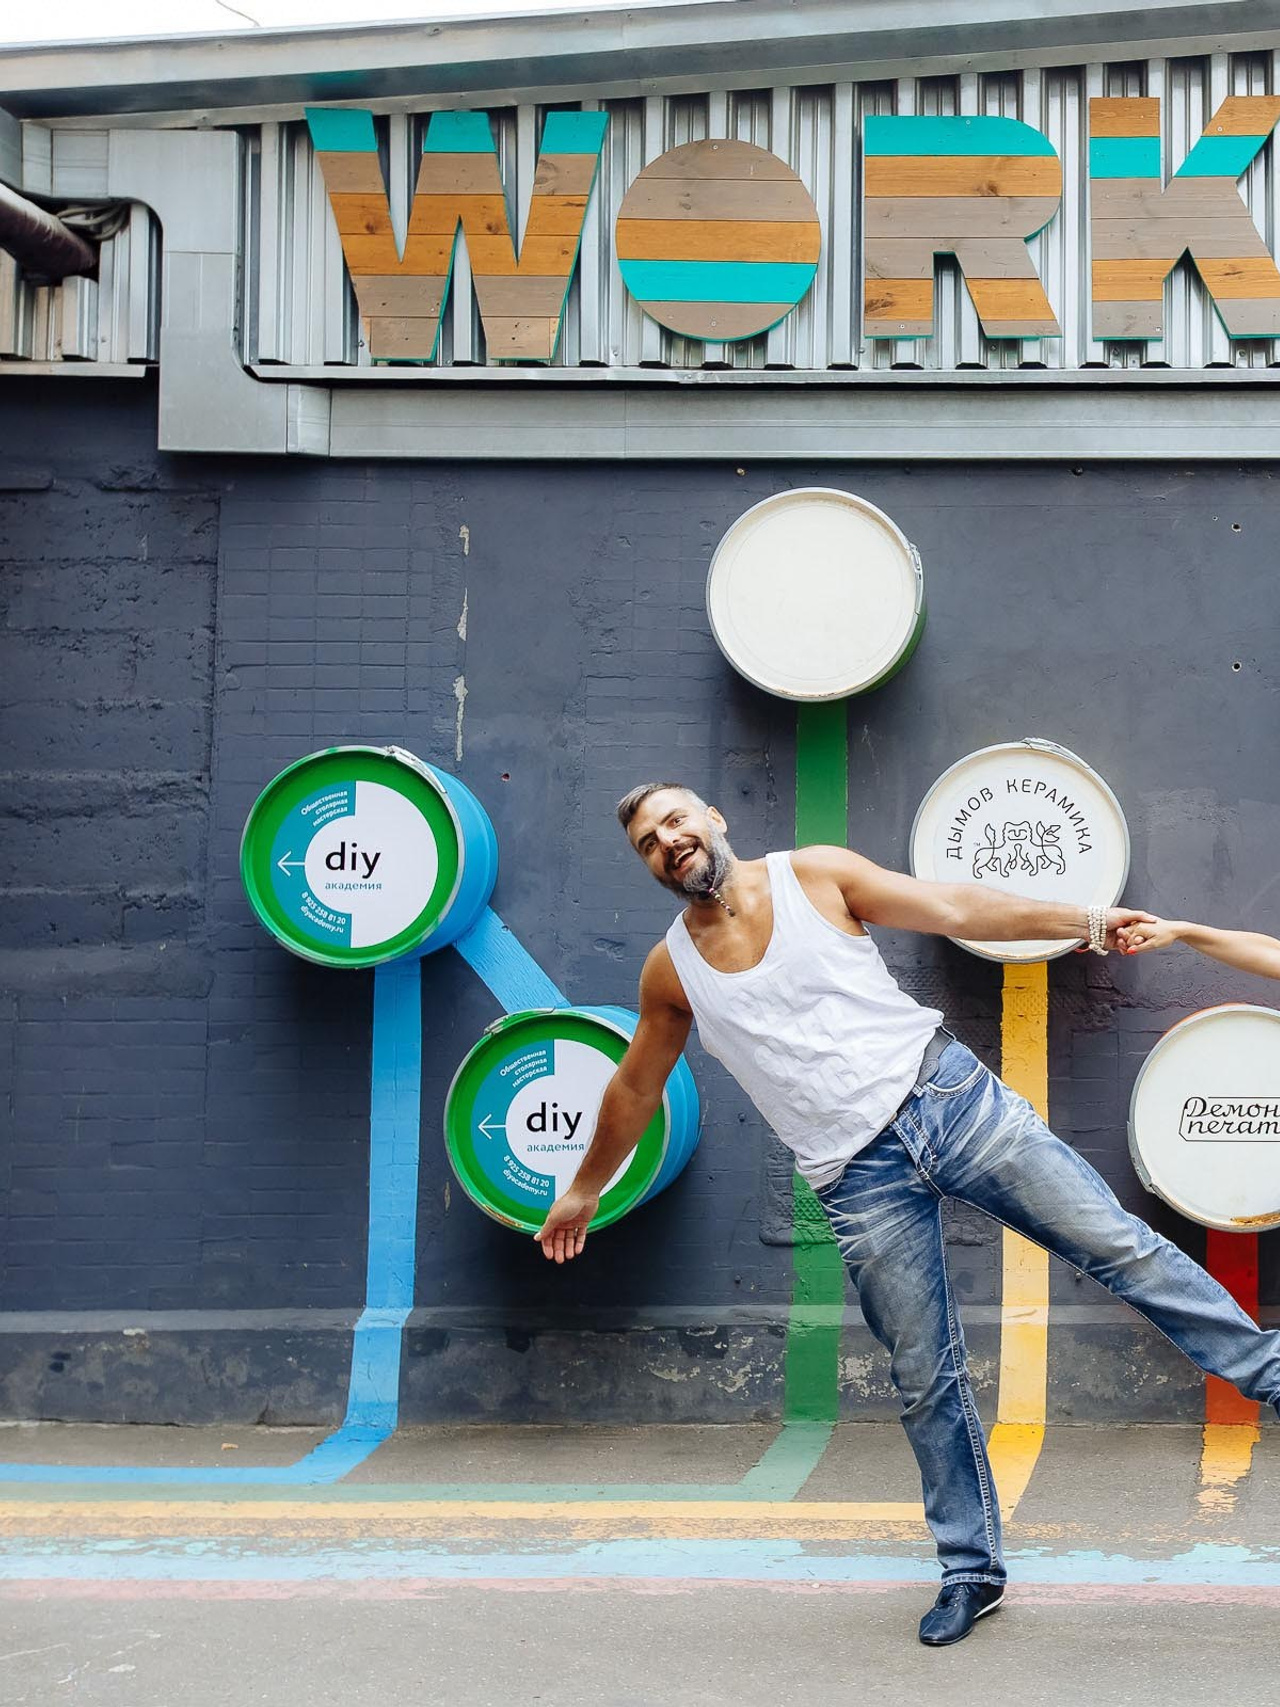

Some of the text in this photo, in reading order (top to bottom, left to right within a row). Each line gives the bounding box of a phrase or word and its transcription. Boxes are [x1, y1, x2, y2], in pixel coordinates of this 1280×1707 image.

[946, 778, 1093, 860] ДЫМОВ КЕРАМИКА
[325, 841, 381, 879] diy
[325, 881, 382, 890] академия
[526, 1102, 582, 1140] diy
[526, 1142, 585, 1153] академия
[503, 1169, 548, 1196] diyacademy.ru
[539, 1179, 550, 1188] 20
